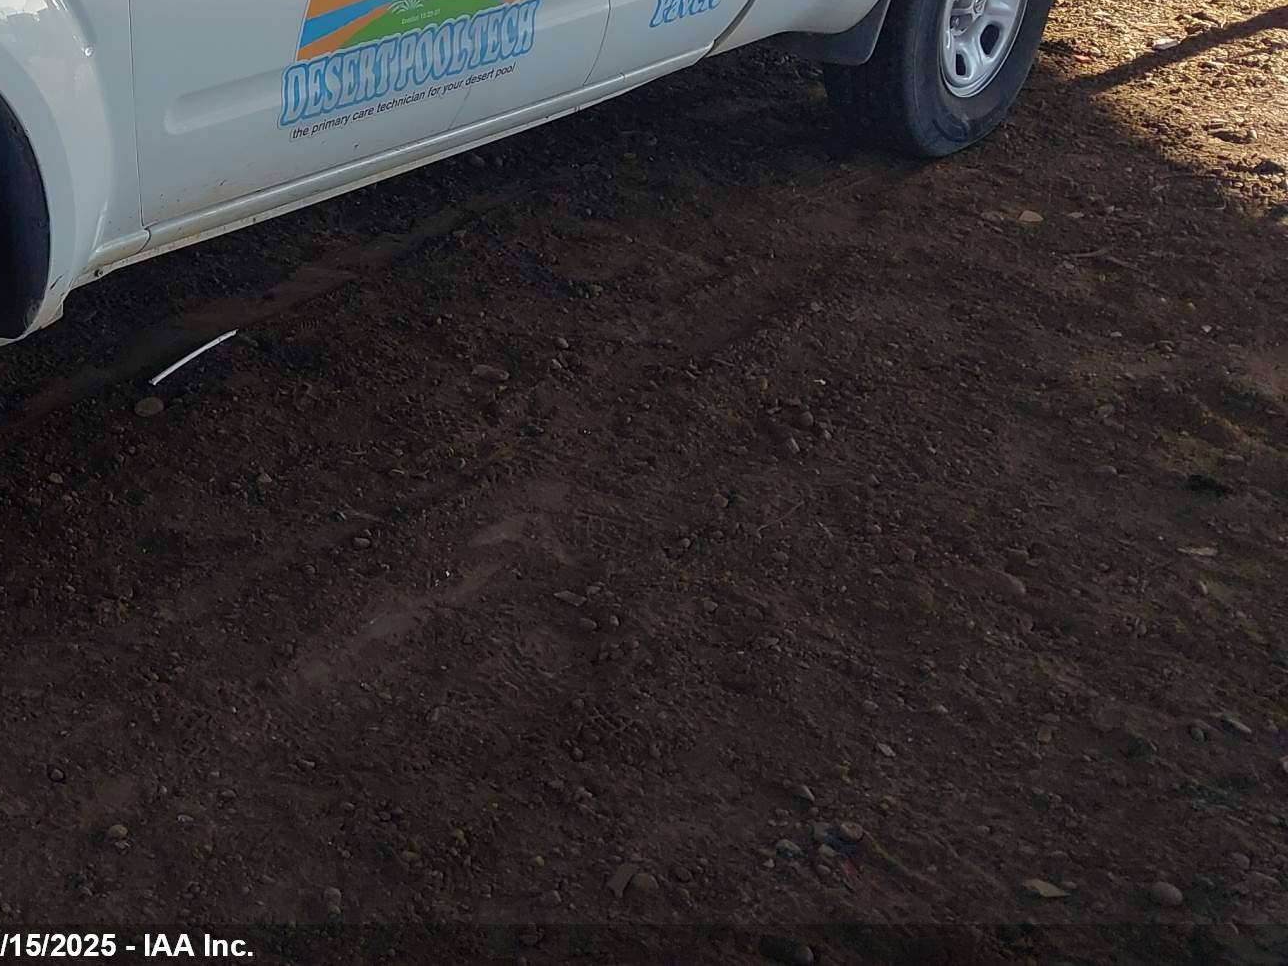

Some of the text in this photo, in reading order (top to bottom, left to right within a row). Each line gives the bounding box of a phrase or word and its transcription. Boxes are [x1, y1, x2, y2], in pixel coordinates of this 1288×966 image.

[292, 61, 517, 139] the primary care technician for your desert pool
